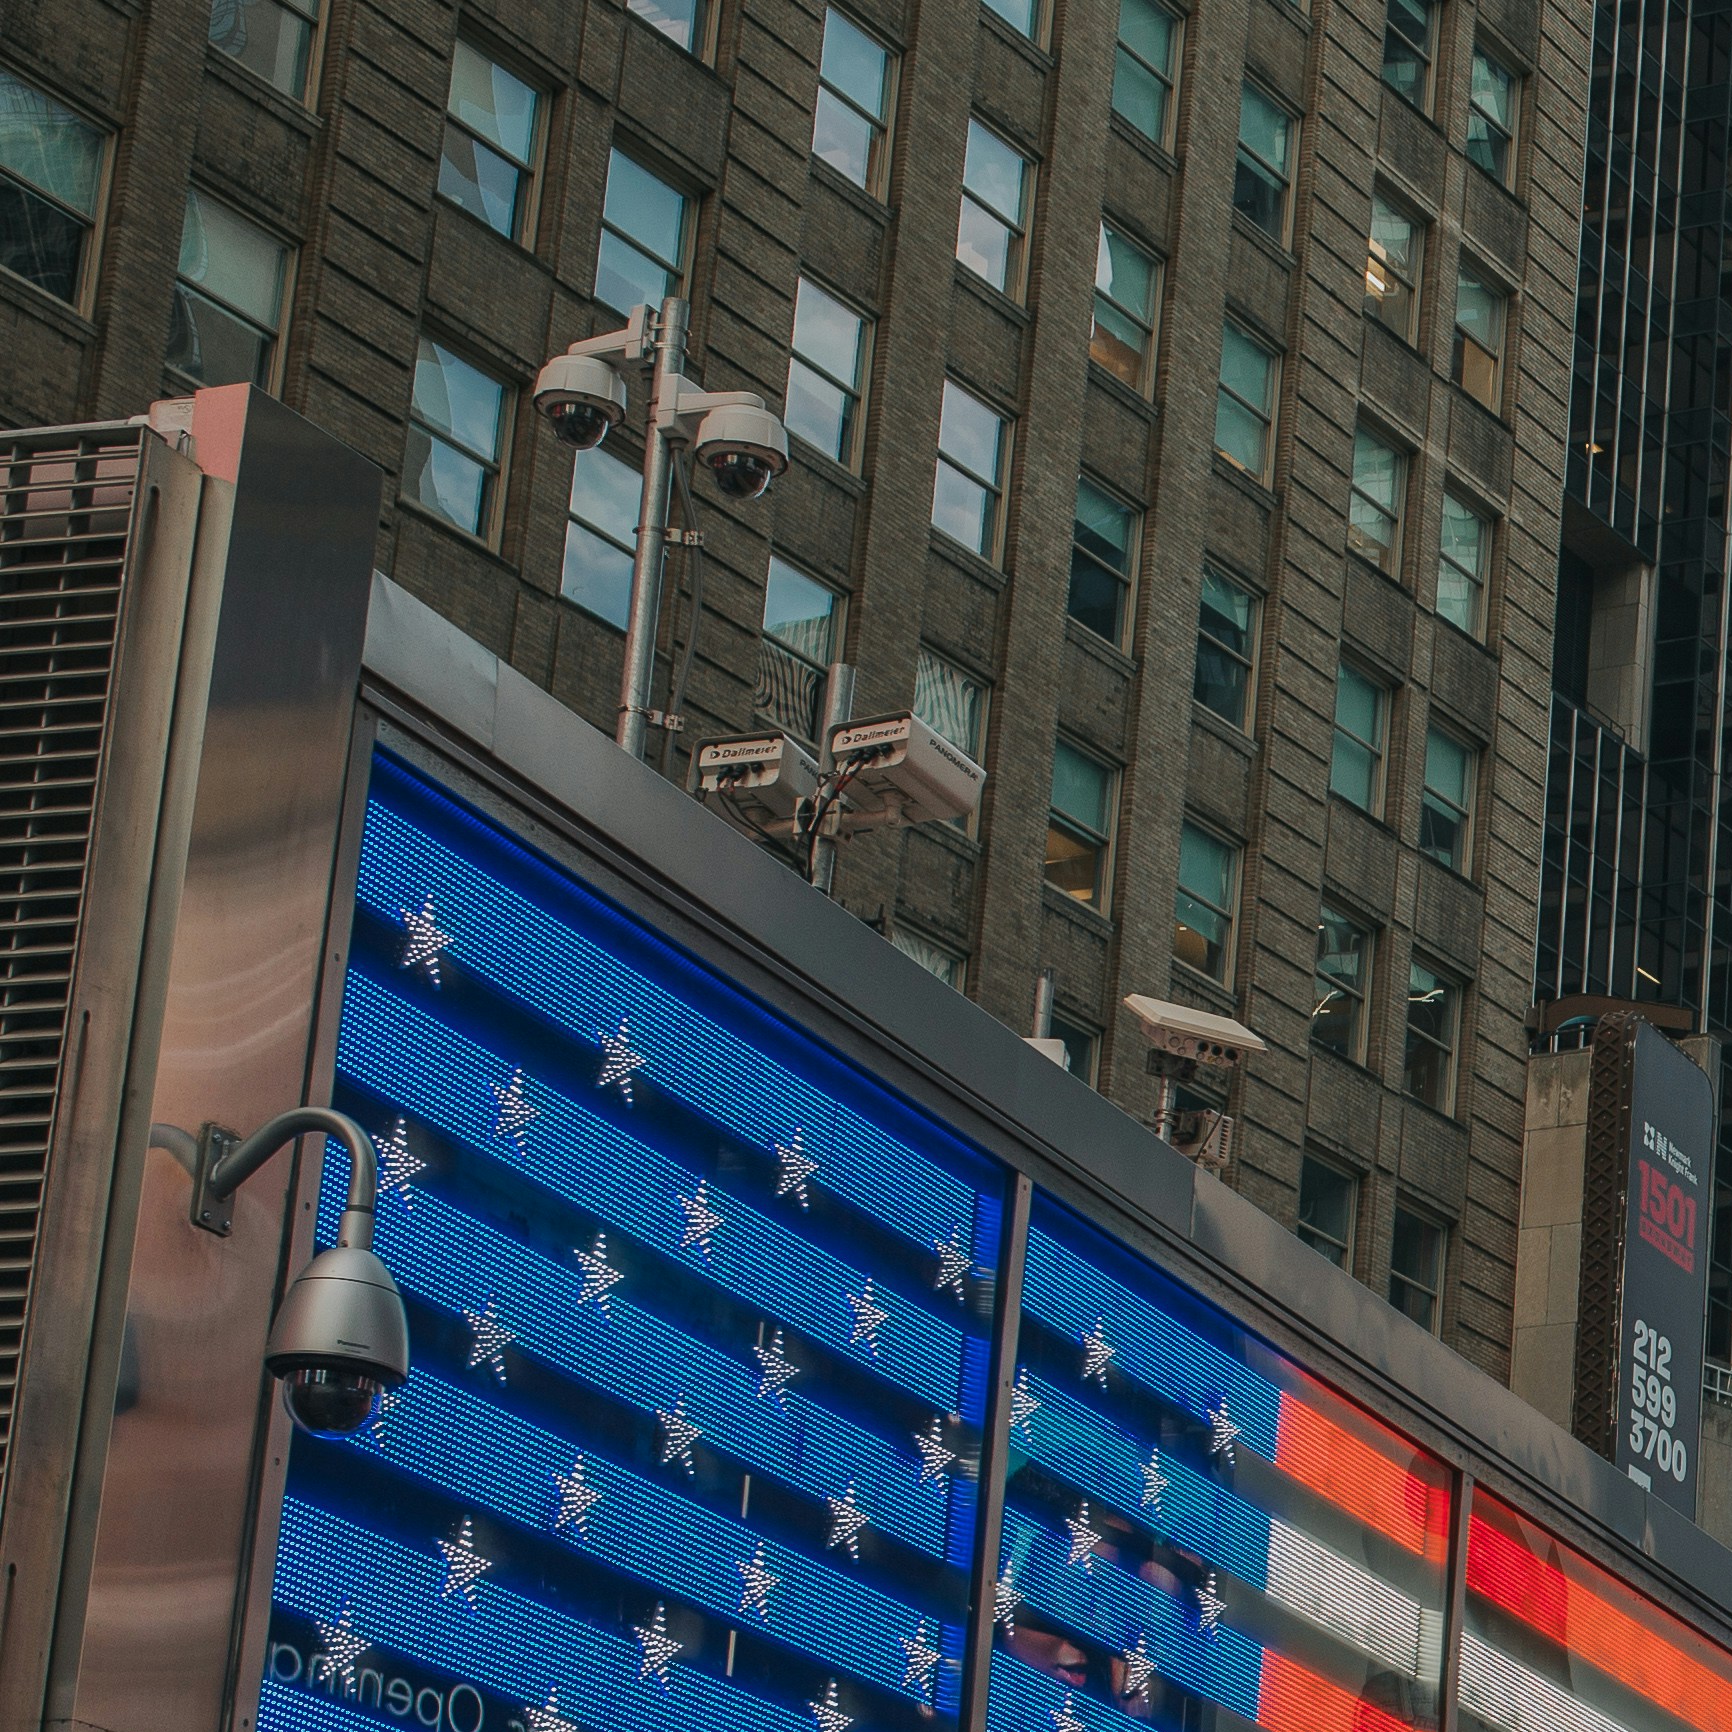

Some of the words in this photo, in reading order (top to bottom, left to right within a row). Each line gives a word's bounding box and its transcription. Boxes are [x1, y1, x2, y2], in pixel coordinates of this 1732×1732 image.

[1638, 1159, 1696, 1249] 1501
[1633, 1319, 1672, 1381] 212
[1632, 1363, 1676, 1428] 599
[1629, 1408, 1687, 1482] 3700
